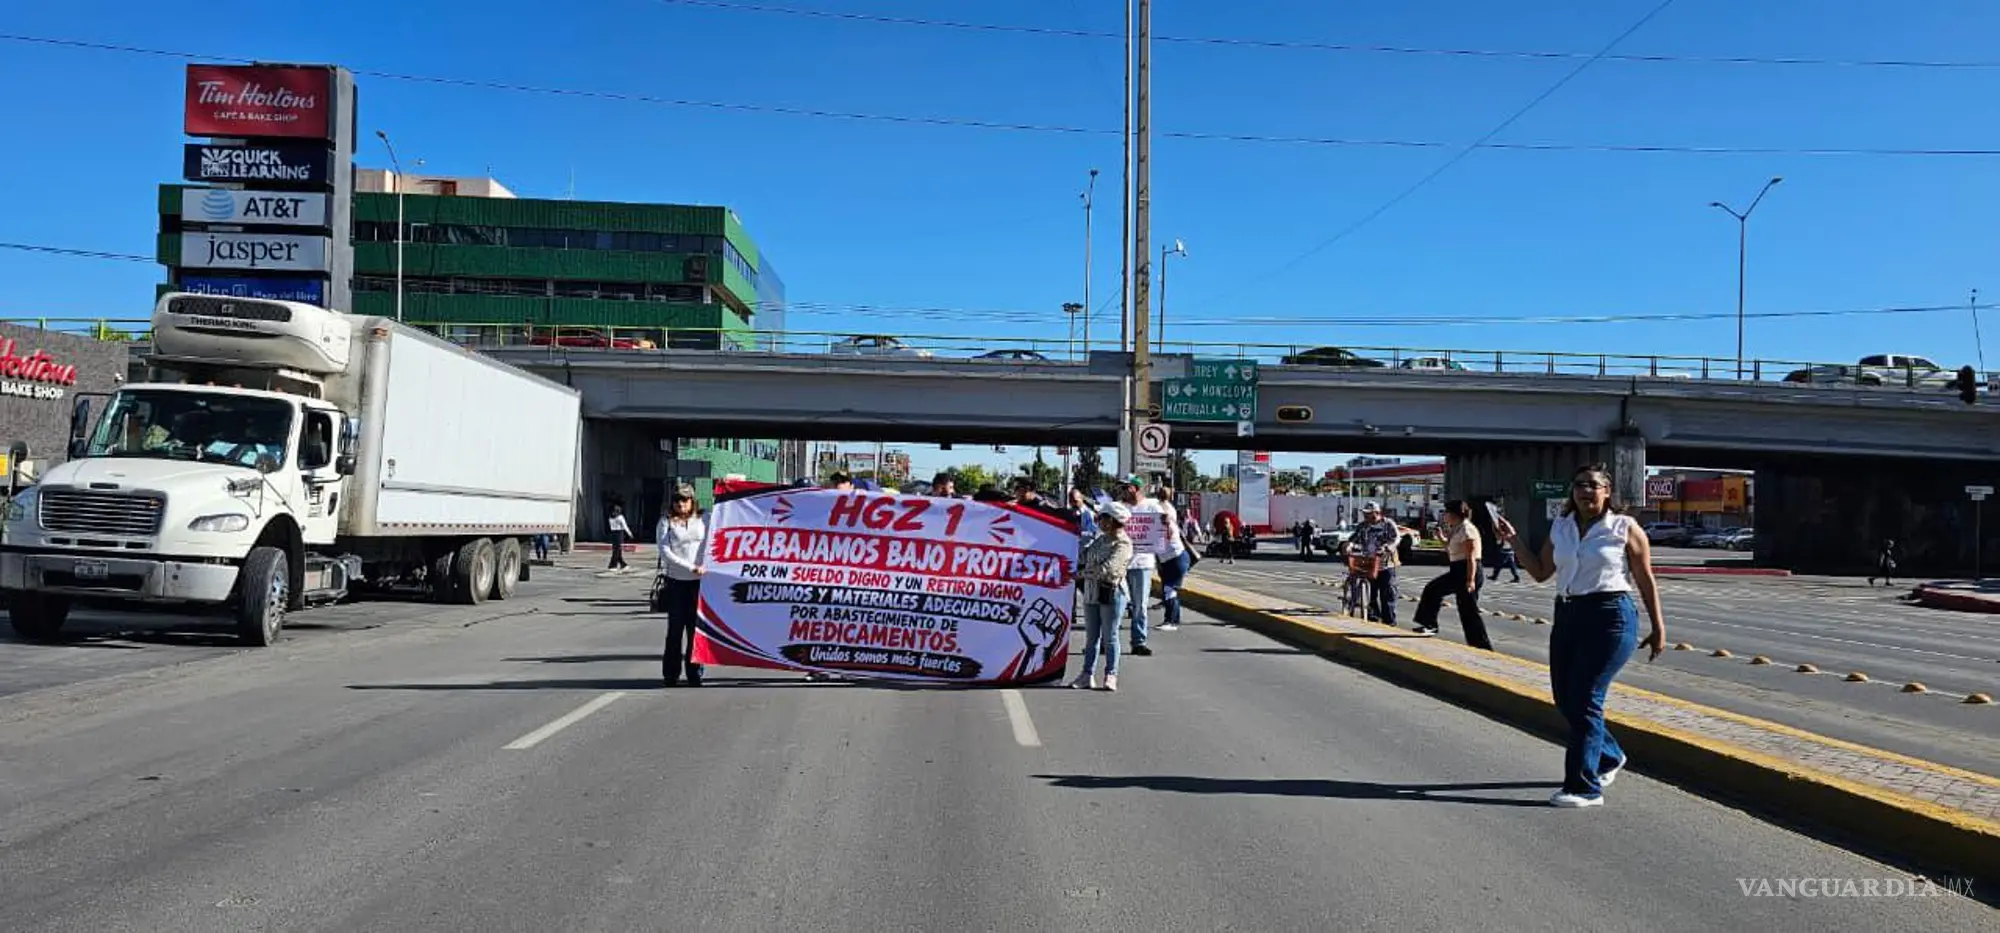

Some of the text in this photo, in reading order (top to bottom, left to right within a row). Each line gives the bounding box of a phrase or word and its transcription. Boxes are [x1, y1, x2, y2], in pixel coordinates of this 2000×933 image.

[198, 81, 315, 108] Tim Hortons
[247, 112, 273, 121] BAKE
[274, 113, 299, 121] SHOP
[231, 149, 282, 165] QUICK
[232, 164, 310, 179] LEARNING
[243, 197, 306, 218] AT&T
[207, 235, 299, 266] jasper
[190, 316, 257, 330] THERMO KING
[1, 381, 64, 400] BAKE SHOP
[829, 495, 965, 536] HGZ 1
[722, 529, 1062, 585] TRABAJAMOS BAJO PROTESTA
[740, 563, 1026, 605] POR UN SUELDO DIGNO Y UN RETIRO DIGNO,
[746, 581, 1014, 623] INSUMOS Y MATERIALES ADECUADOS,
[790, 605, 959, 632] POR ABASTECIMIENTO DE
[788, 619, 962, 653] MEDICAMENTOS.
[810, 646, 962, 674] Unidos somos más fuertes
